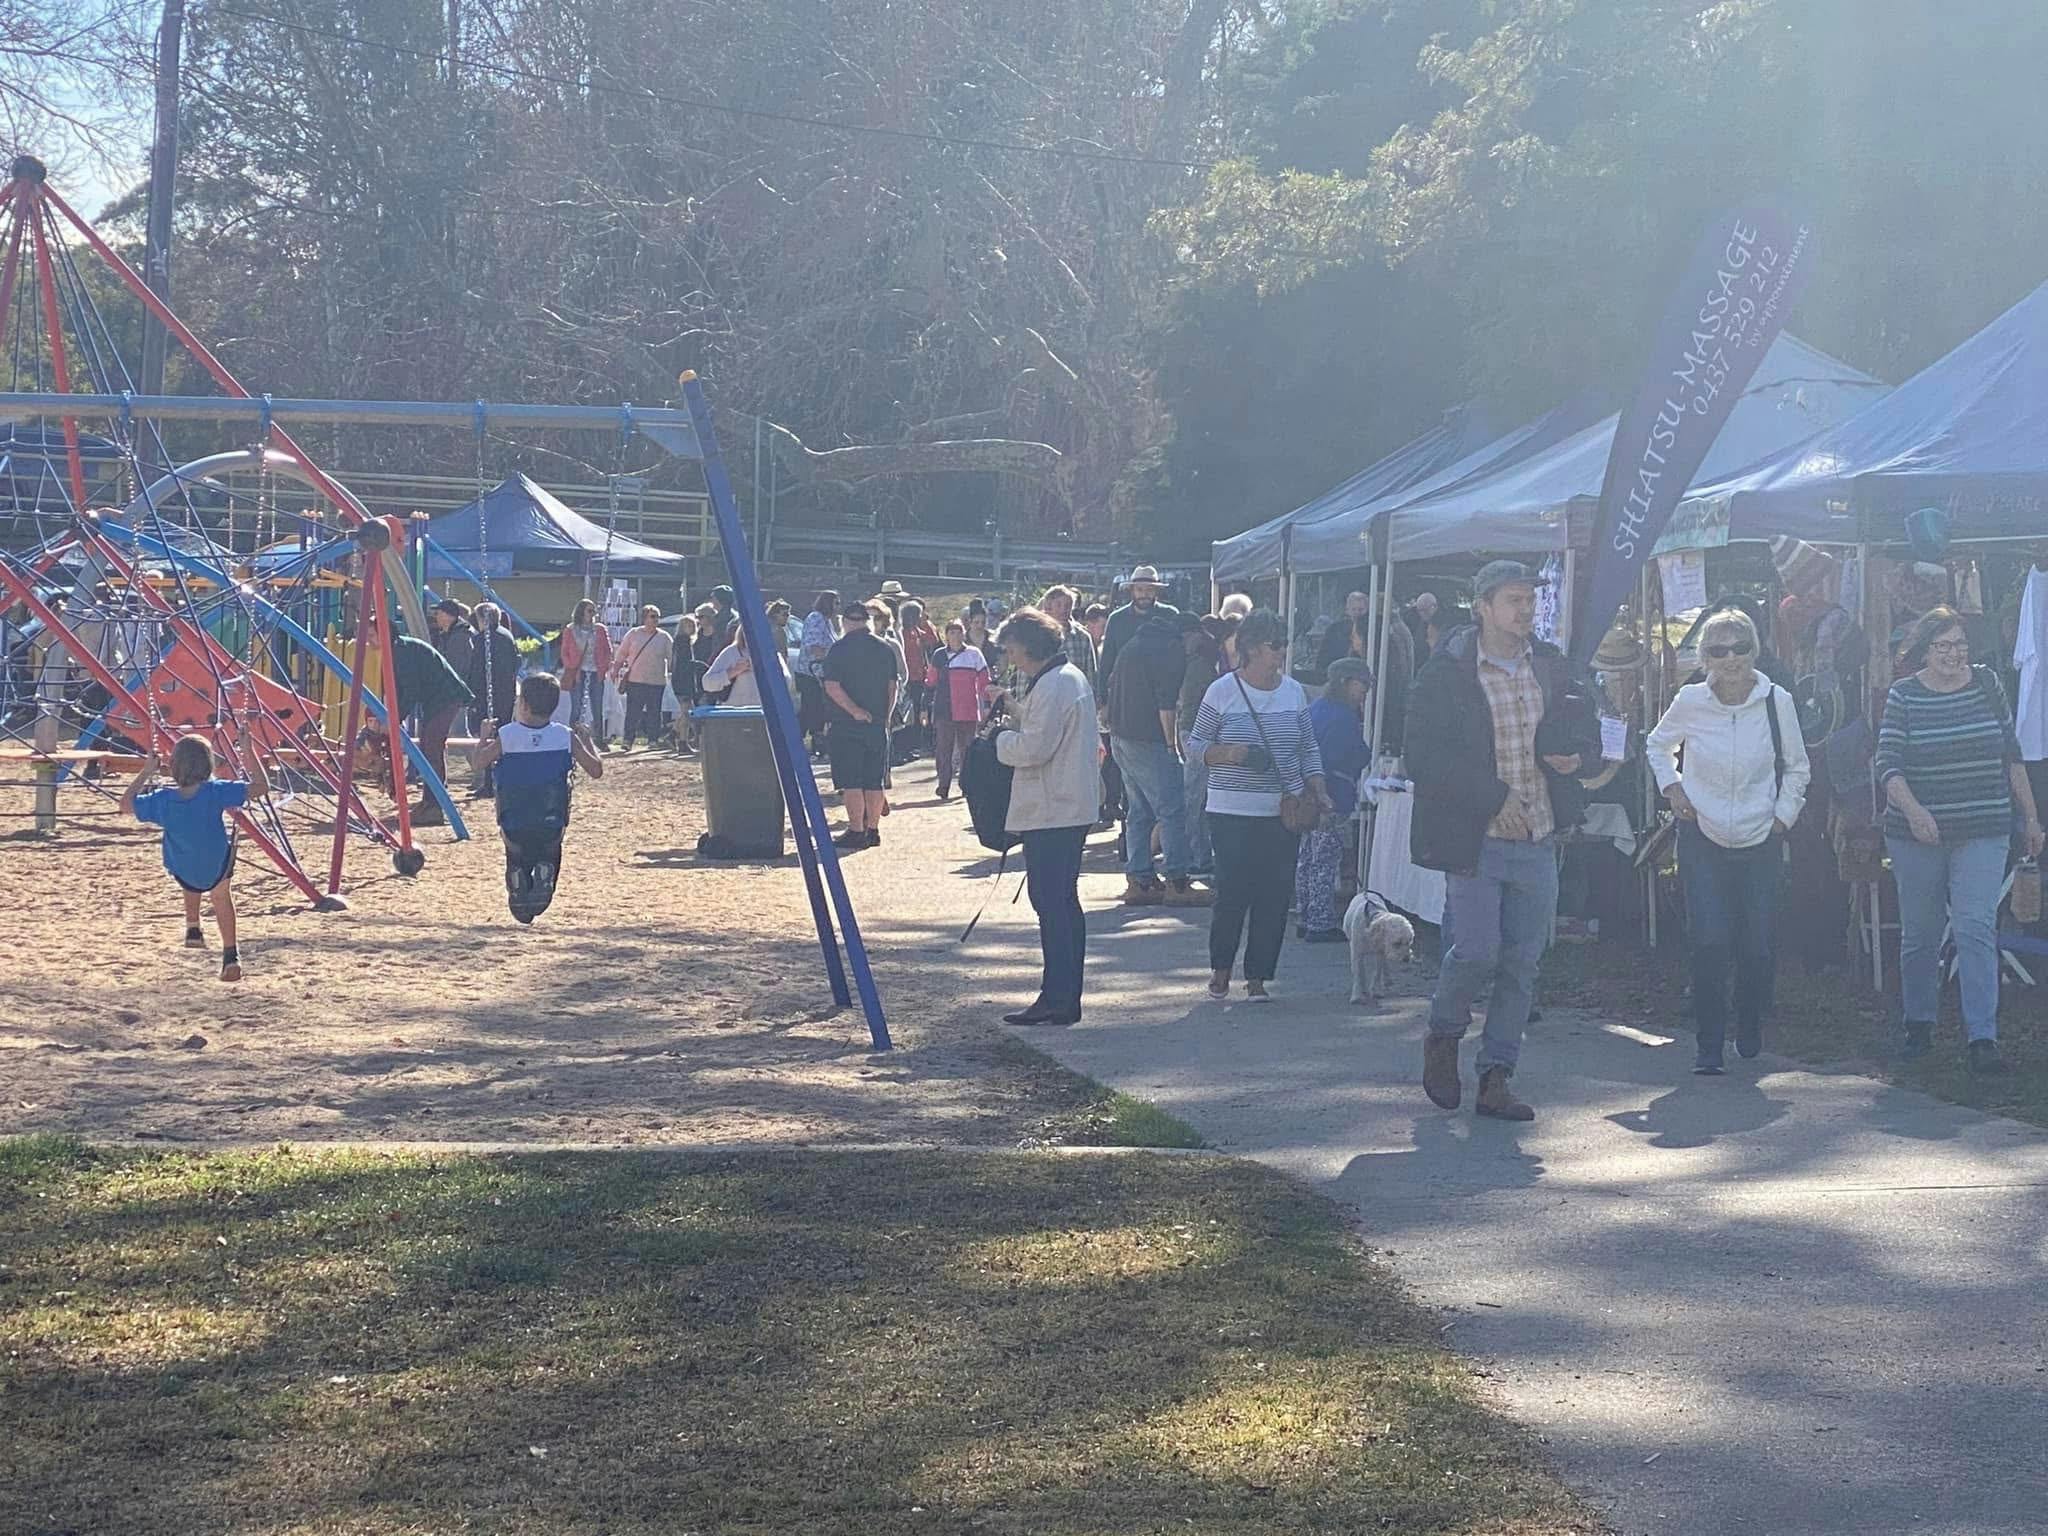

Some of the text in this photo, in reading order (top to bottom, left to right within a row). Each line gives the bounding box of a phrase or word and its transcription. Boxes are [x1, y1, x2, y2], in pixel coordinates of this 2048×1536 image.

[1693, 245, 1778, 415] 0437 529 212
[1745, 224, 1809, 347] by appointment
[1613, 219, 1757, 559] SHIATSU-MASSAGE
